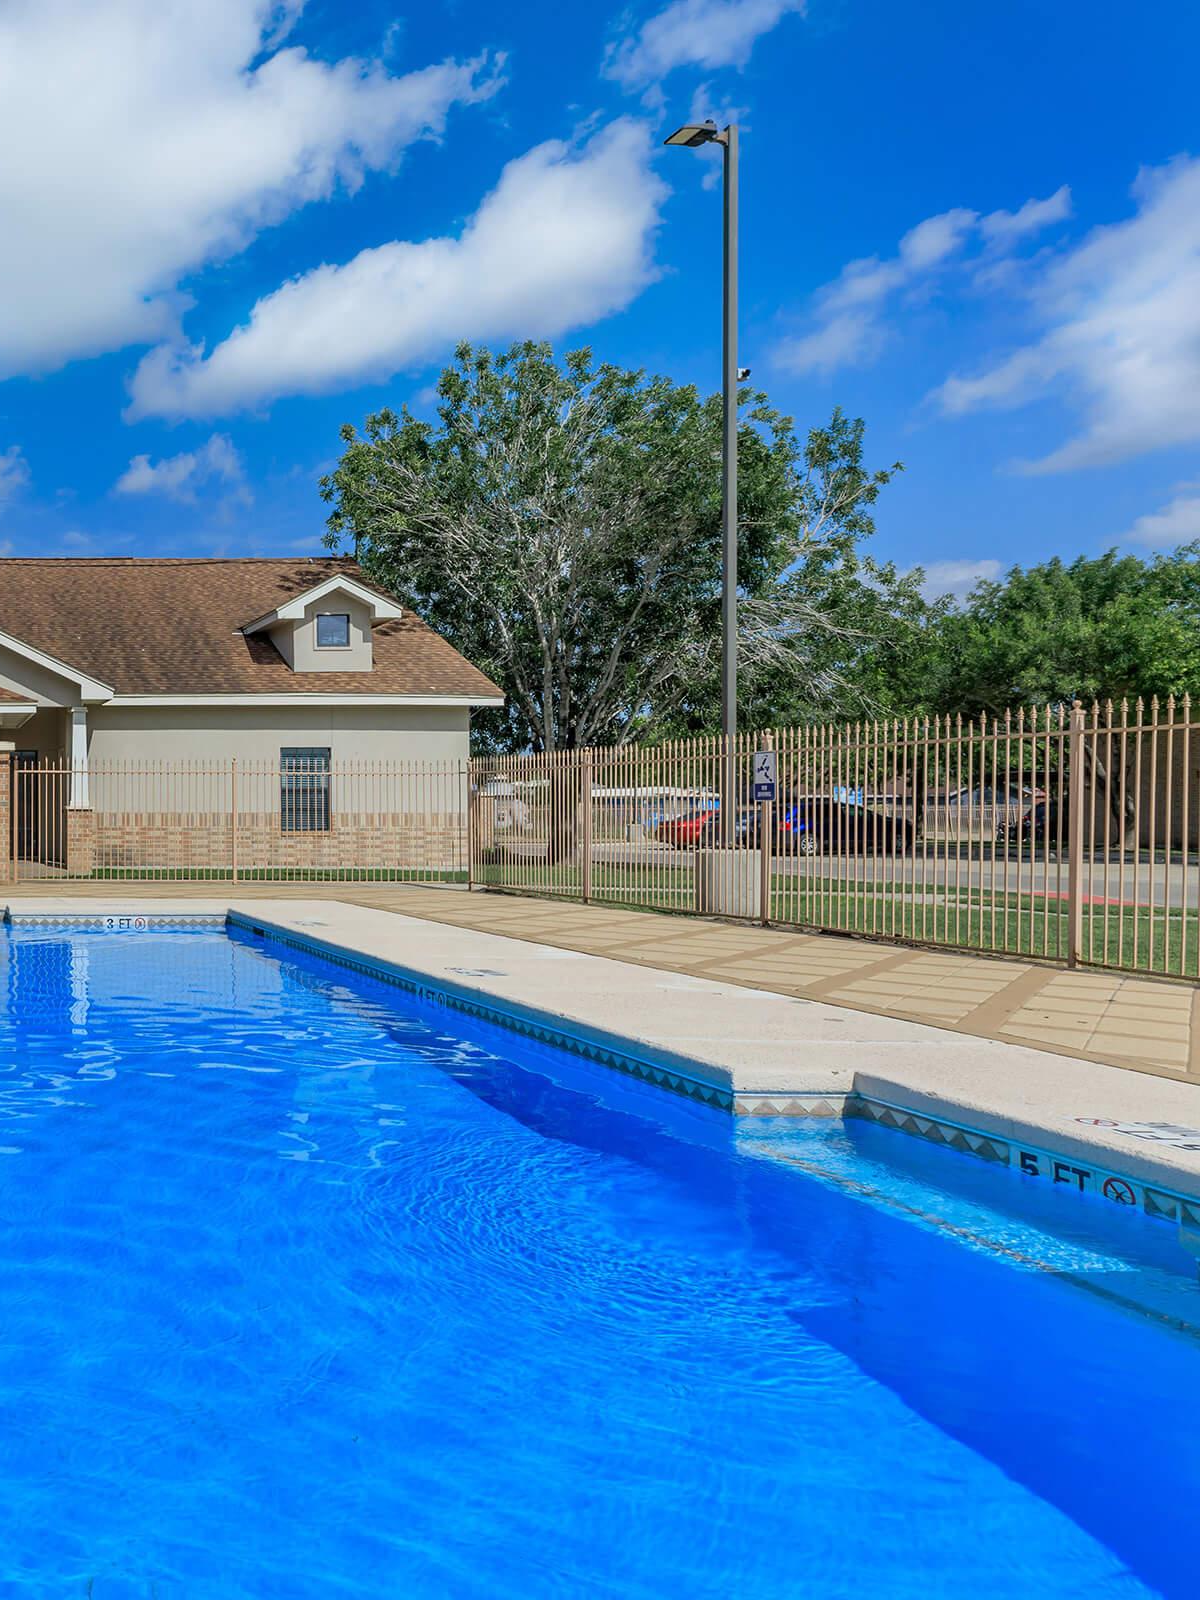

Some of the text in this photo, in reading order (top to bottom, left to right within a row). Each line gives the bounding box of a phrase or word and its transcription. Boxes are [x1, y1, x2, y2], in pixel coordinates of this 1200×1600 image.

[106, 918, 132, 929] 3 FT
[1019, 1151, 1091, 1193] 5 FT
